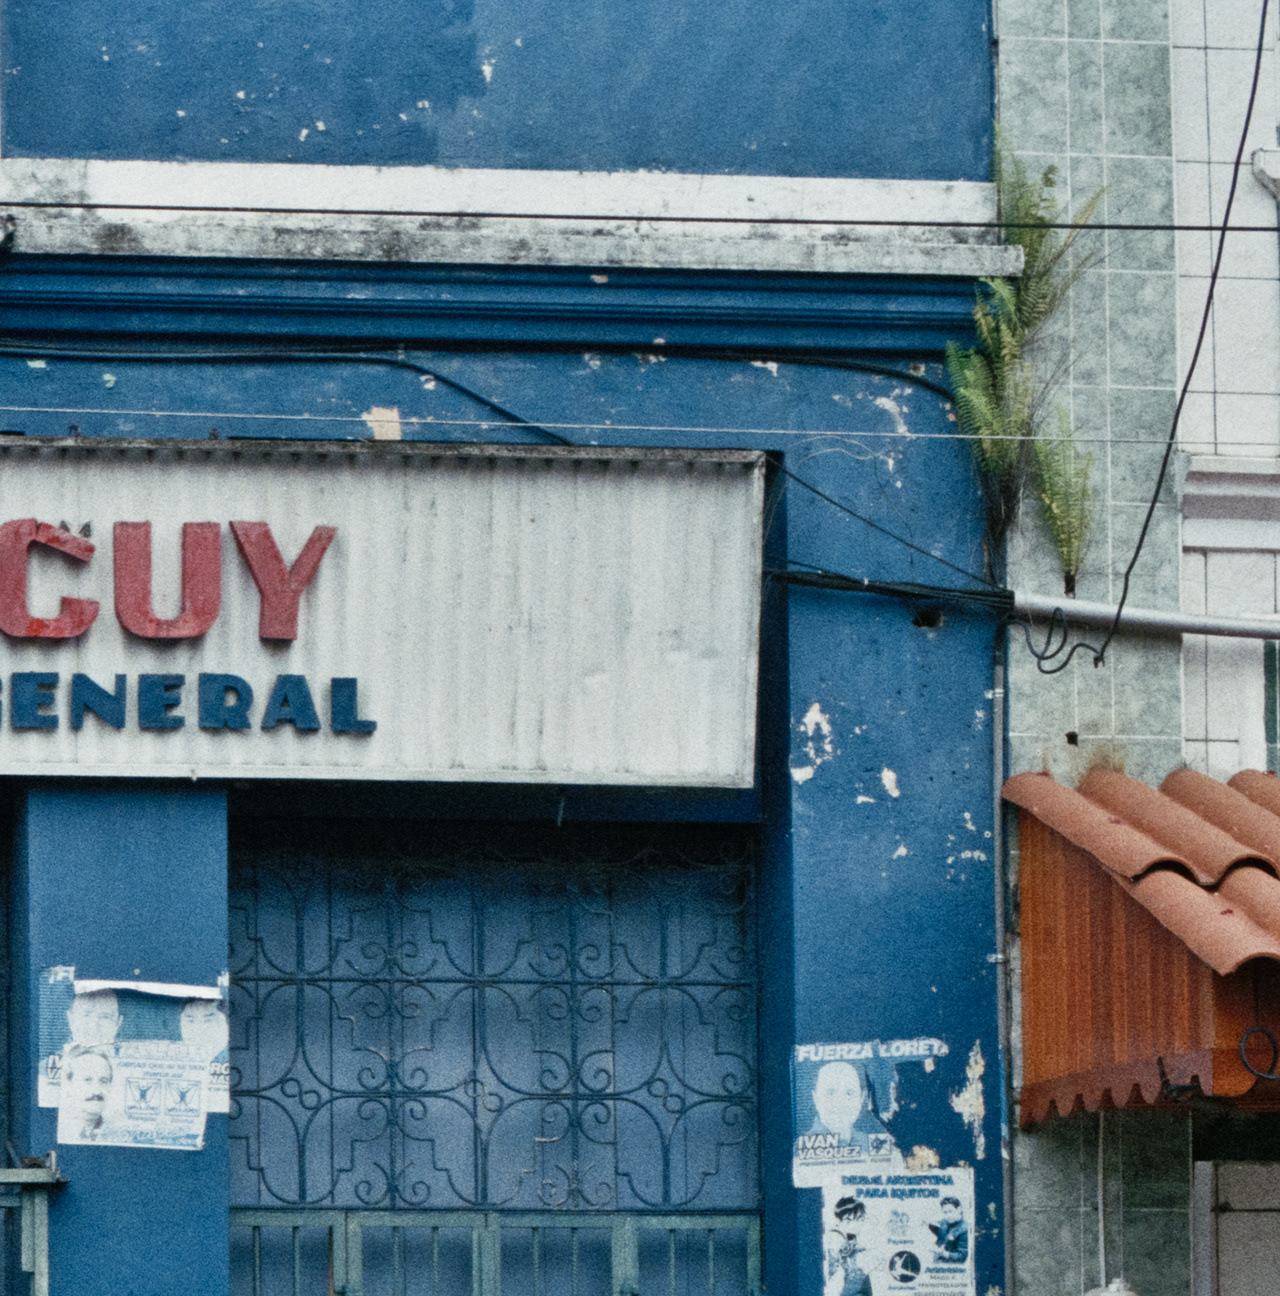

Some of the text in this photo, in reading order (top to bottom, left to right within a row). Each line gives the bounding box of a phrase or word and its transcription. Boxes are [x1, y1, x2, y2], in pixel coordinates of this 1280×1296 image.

[798, 1133, 840, 1149] IVAN
[798, 1146, 861, 1160] VASQUEZ
[856, 1188, 889, 1198] PARA
